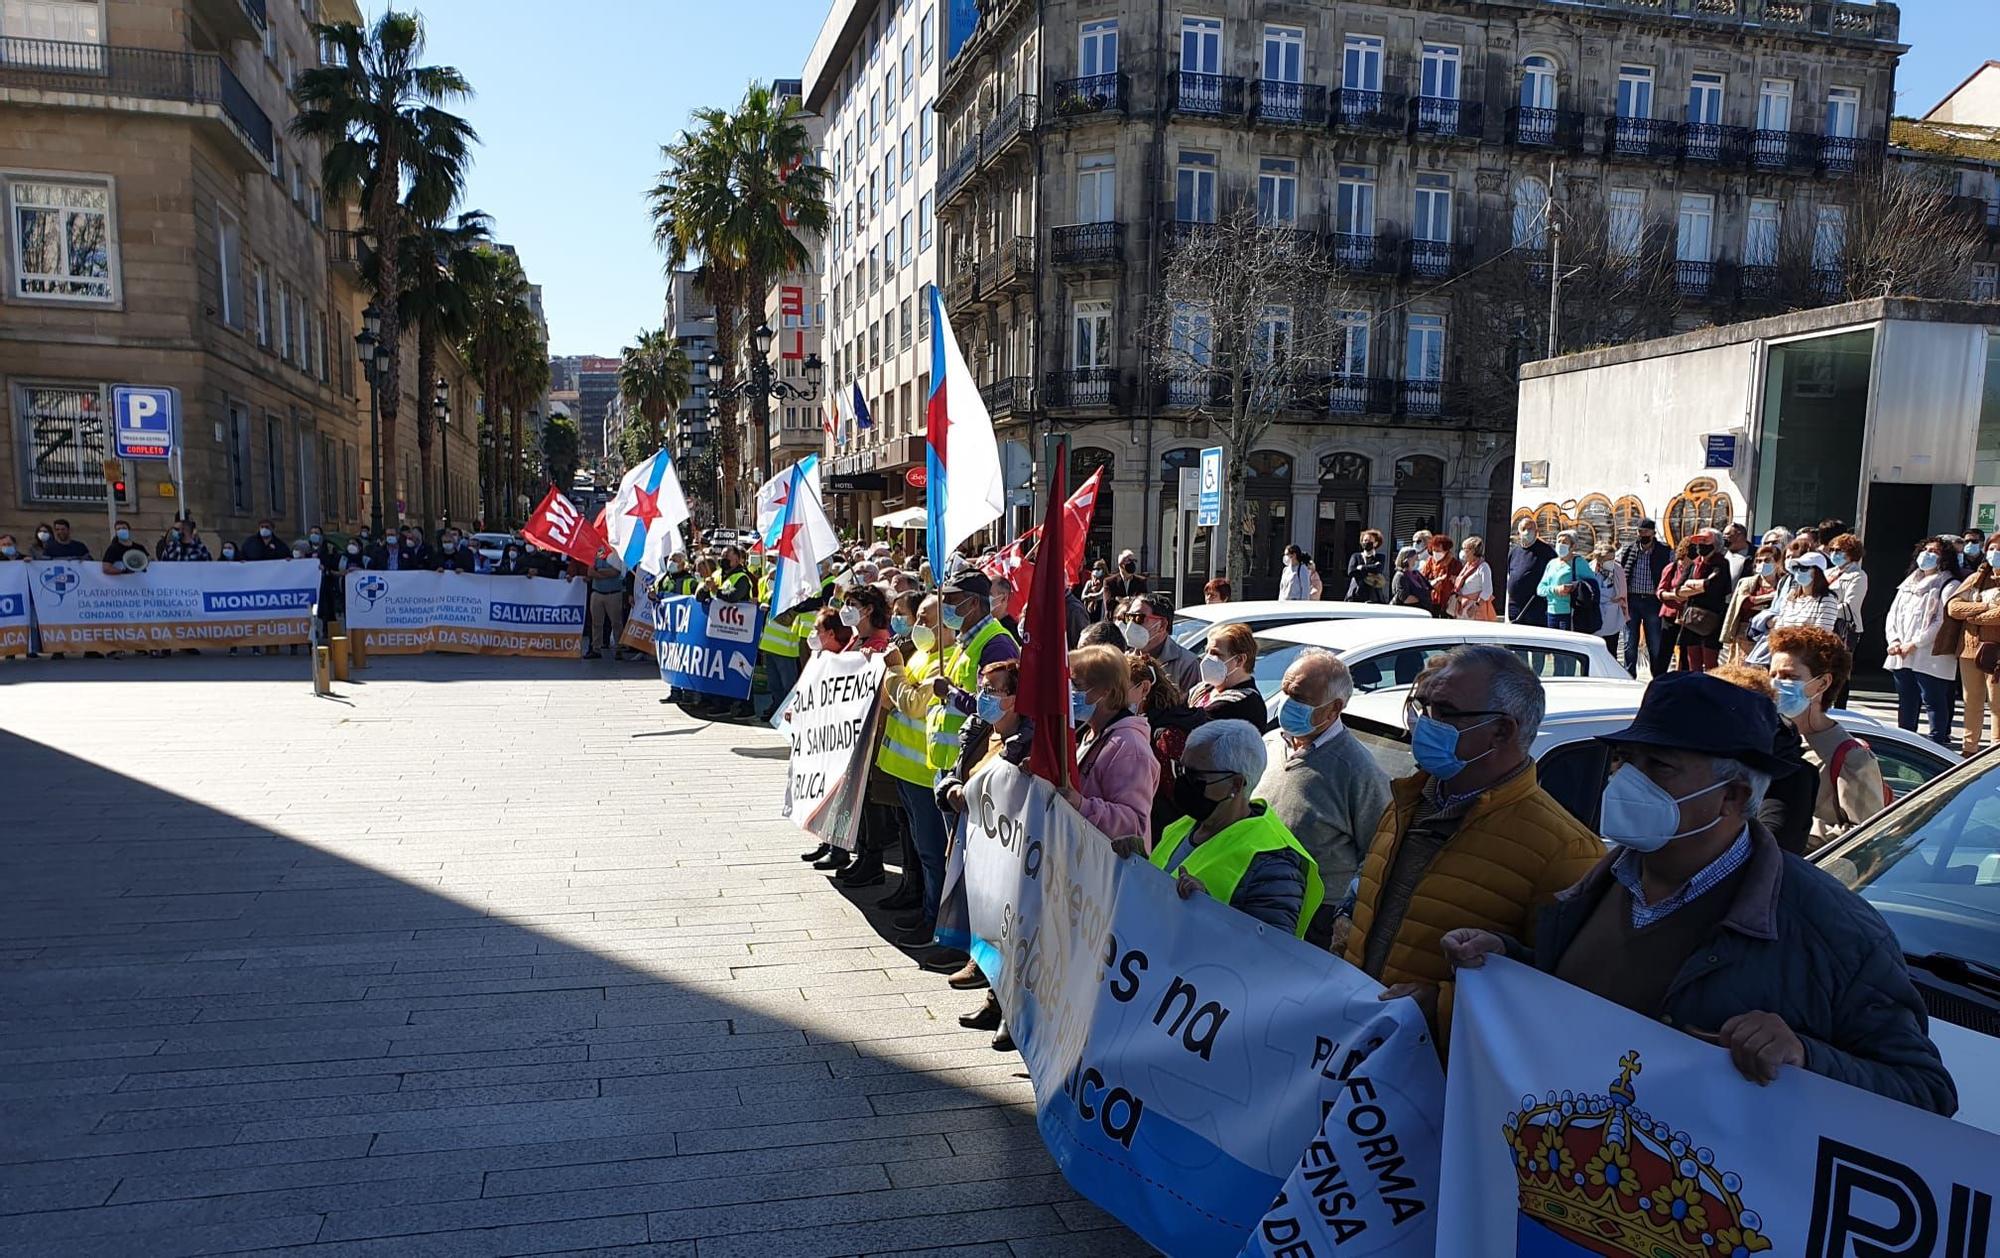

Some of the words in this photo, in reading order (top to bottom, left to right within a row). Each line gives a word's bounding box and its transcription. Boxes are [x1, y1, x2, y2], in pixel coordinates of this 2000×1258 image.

[129, 395, 157, 428] P
[127, 446, 164, 455] COMPLETO
[77, 588, 138, 598] PLATAFORMA
[141, 587, 155, 597] EN
[157, 587, 200, 597] DEFENSA
[211, 593, 310, 609] MONDARIZ
[447, 595, 482, 604] DEFENSA
[77, 600, 92, 609] DA
[94, 599, 141, 608] SANIDADE
[185, 598, 198, 607] DO
[385, 607, 396, 615] DA
[470, 606, 482, 614] DO
[79, 611, 124, 619] CONDADO
[386, 616, 424, 624] CONDADO
[492, 604, 582, 623] SALVATERRA
[675, 603, 692, 633] DA
[0, 631, 26, 648] LICA
[43, 629, 66, 642] NA
[71, 627, 147, 641] DEFENSA
[151, 625, 173, 640] DA
[176, 624, 254, 639] SANIDADE
[257, 621, 311, 635] PÚBLIC
[378, 630, 435, 646] DEFENSA
[438, 630, 458, 644] DA
[461, 632, 527, 648] SANIDADE
[627, 624, 656, 644] DEFE
[821, 670, 876, 708] DEFENSA
[807, 718, 861, 756] SANIDADE
[794, 772, 825, 800] BLICA
[981, 793, 1043, 881] Cona
[1152, 975, 1231, 1063] na
